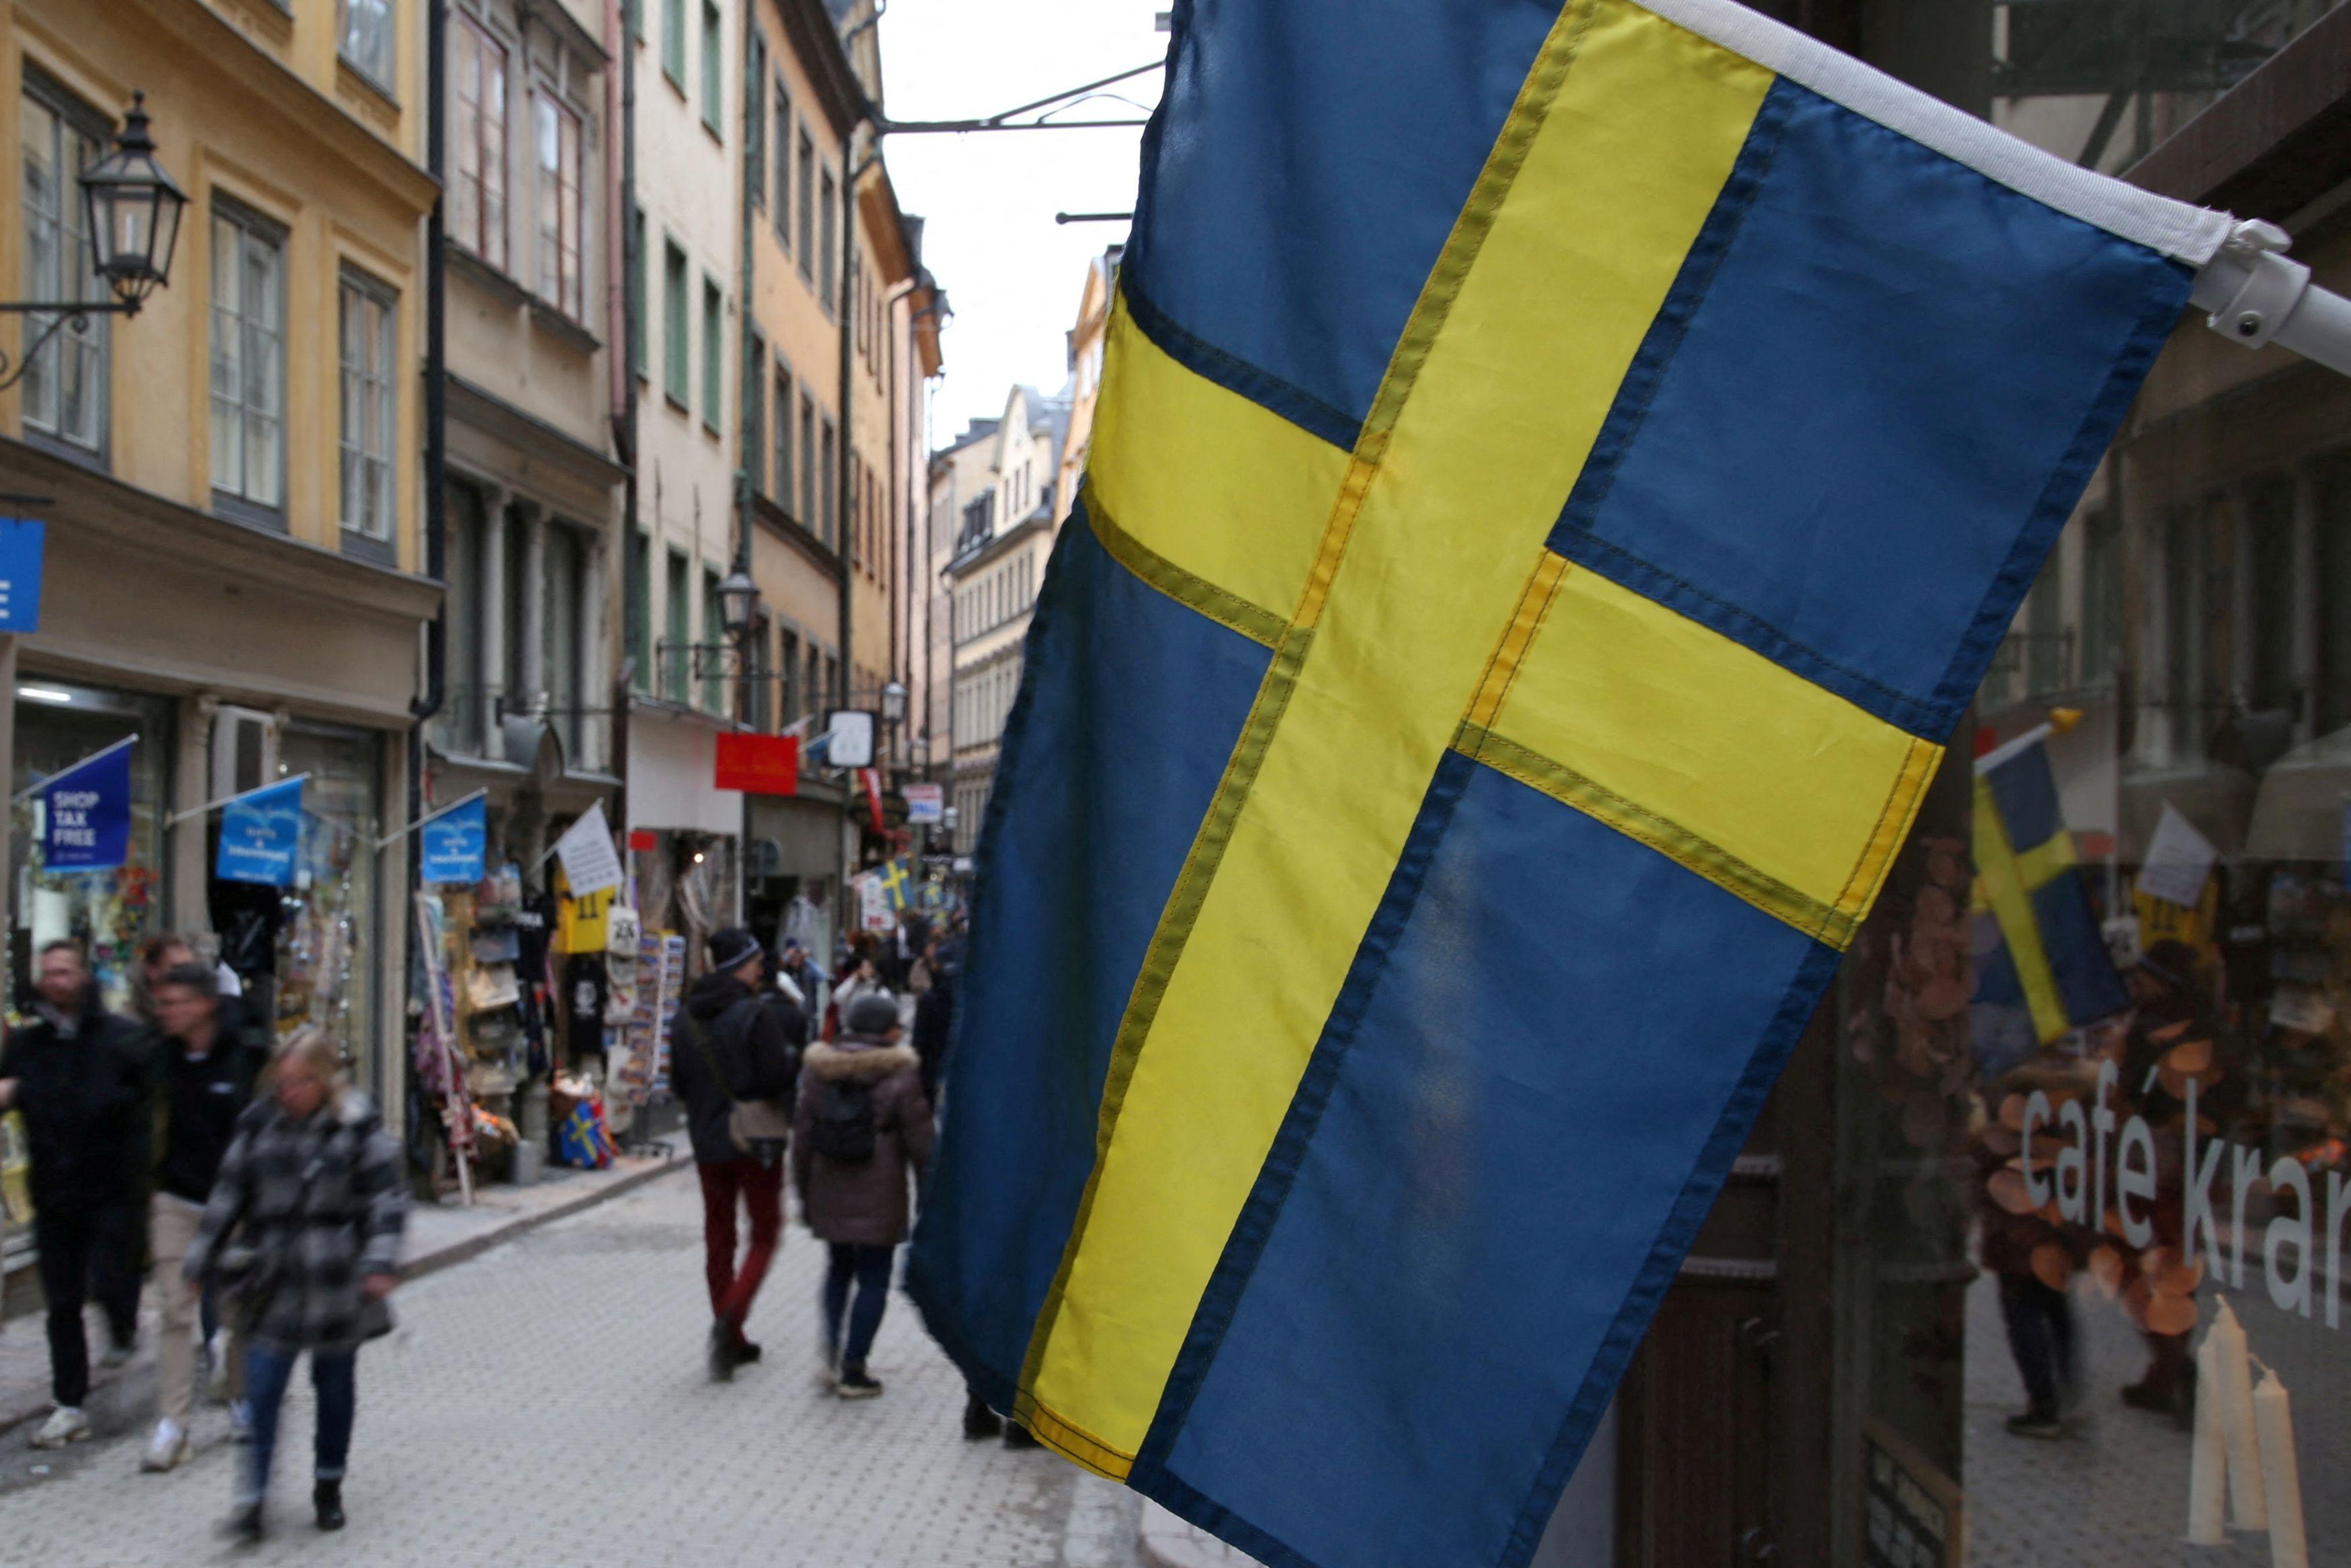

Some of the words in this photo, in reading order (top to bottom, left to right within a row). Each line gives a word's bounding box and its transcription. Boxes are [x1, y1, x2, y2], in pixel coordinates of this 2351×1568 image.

[54, 791, 99, 809] SHOP
[54, 809, 87, 827] TAX
[54, 828, 96, 846] FREE
[2021, 1058, 2160, 1249] café
